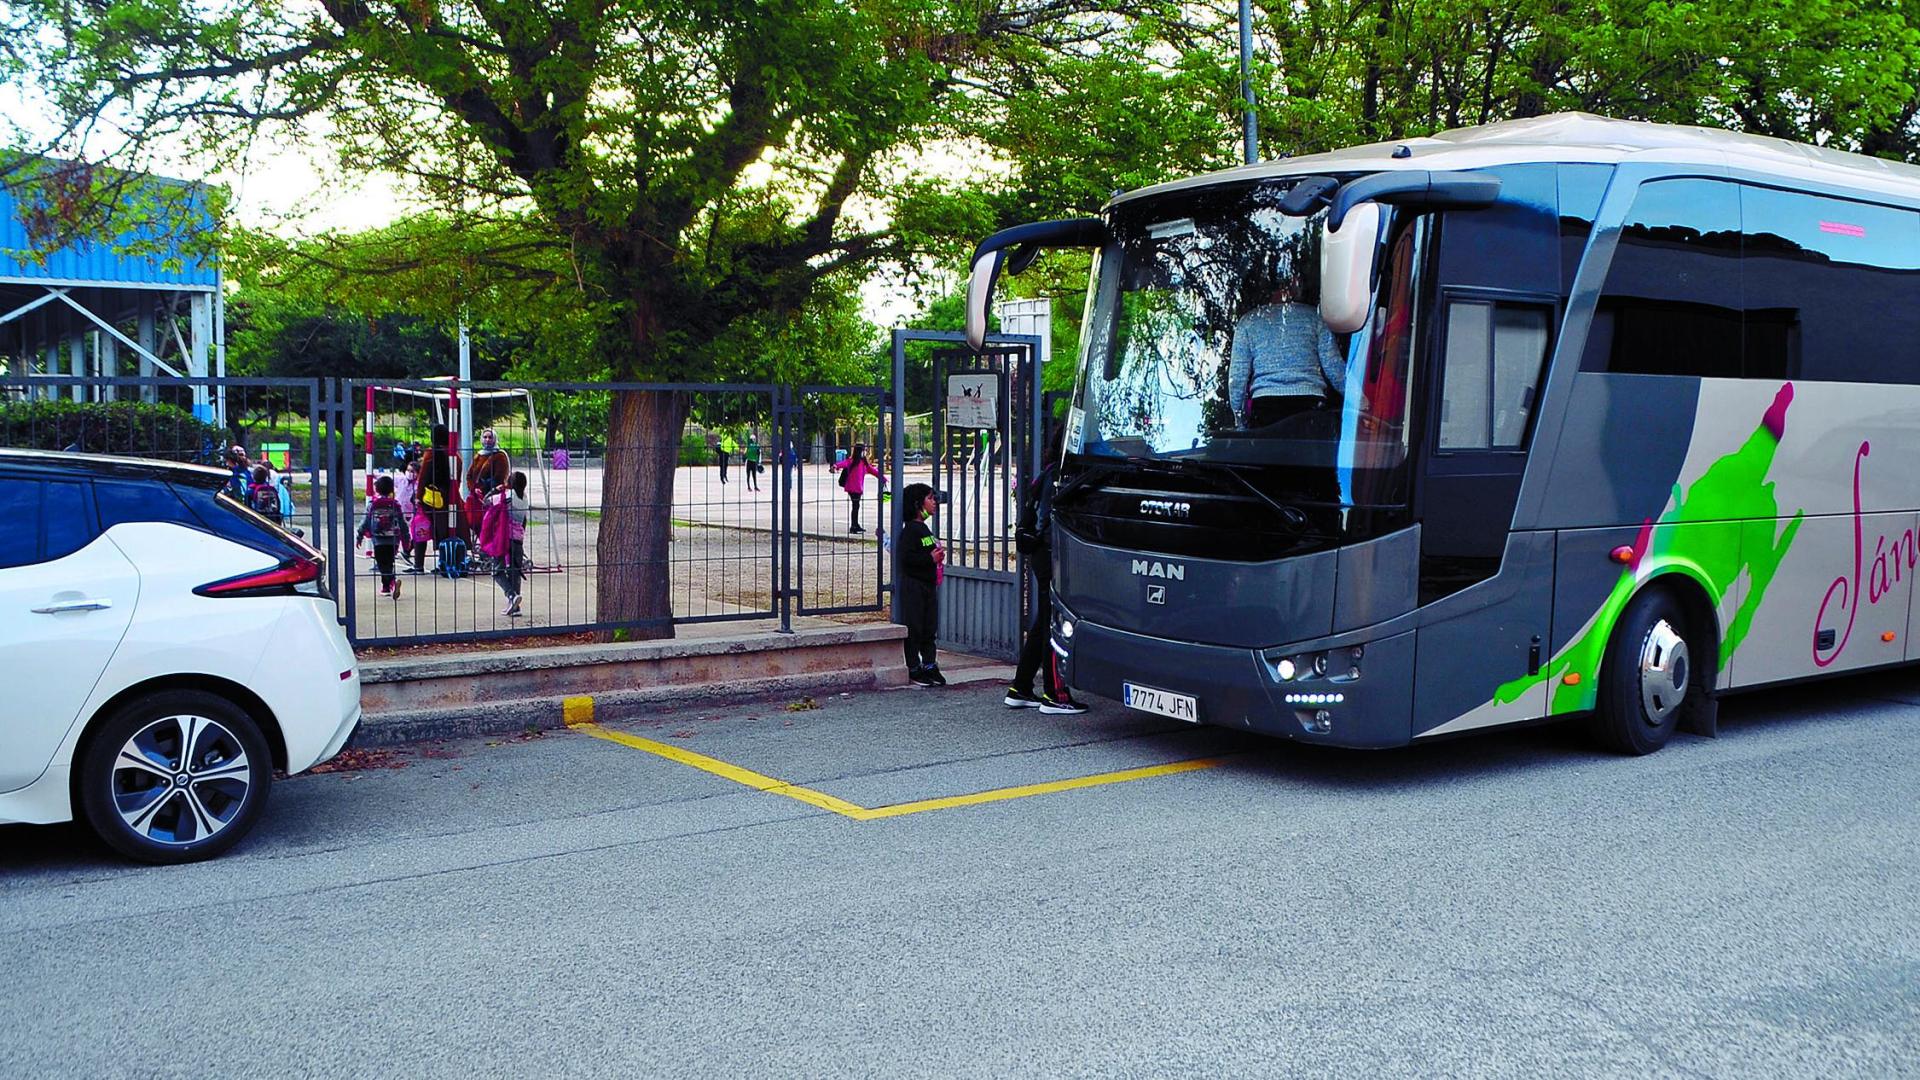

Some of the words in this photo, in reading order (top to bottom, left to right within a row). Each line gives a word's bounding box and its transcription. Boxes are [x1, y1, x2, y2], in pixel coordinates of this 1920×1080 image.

[1140, 500, 1191, 517] OTOKAR
[1813, 441, 1920, 667] Sán
[1132, 559, 1185, 580] MAN
[1132, 688, 1163, 711] 7774
[1169, 697, 1193, 718] JFN
